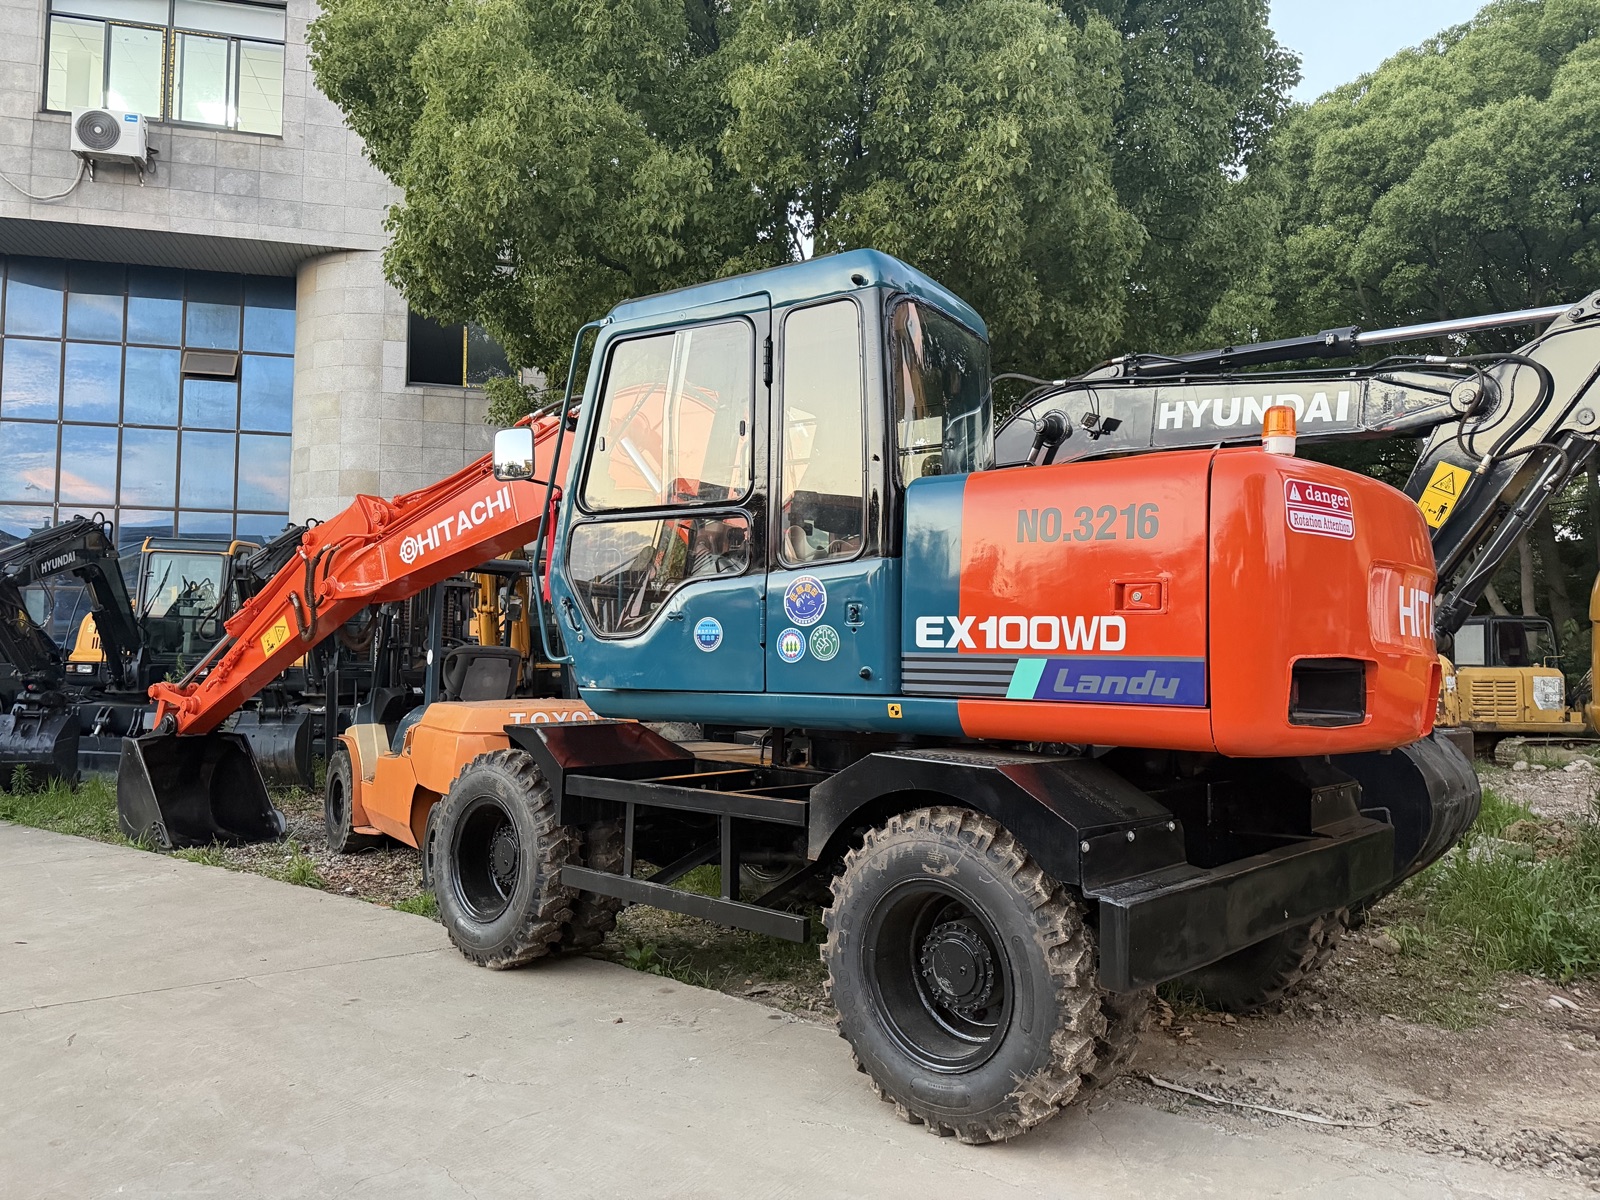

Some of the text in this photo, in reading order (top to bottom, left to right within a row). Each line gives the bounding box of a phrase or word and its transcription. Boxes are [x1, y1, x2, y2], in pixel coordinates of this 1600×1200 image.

[1158, 391, 1350, 430] HYUNDAI
[1305, 485, 1349, 509] danger
[416, 486, 511, 556] HITACHI
[1017, 503, 1159, 543] NO.3216
[1293, 513, 1351, 534] Rotation Attention
[41, 551, 76, 574] HYUNDAI
[915, 615, 1126, 651] EX100WD
[1053, 668, 1181, 699] Landy
[509, 711, 601, 725] TOYO
